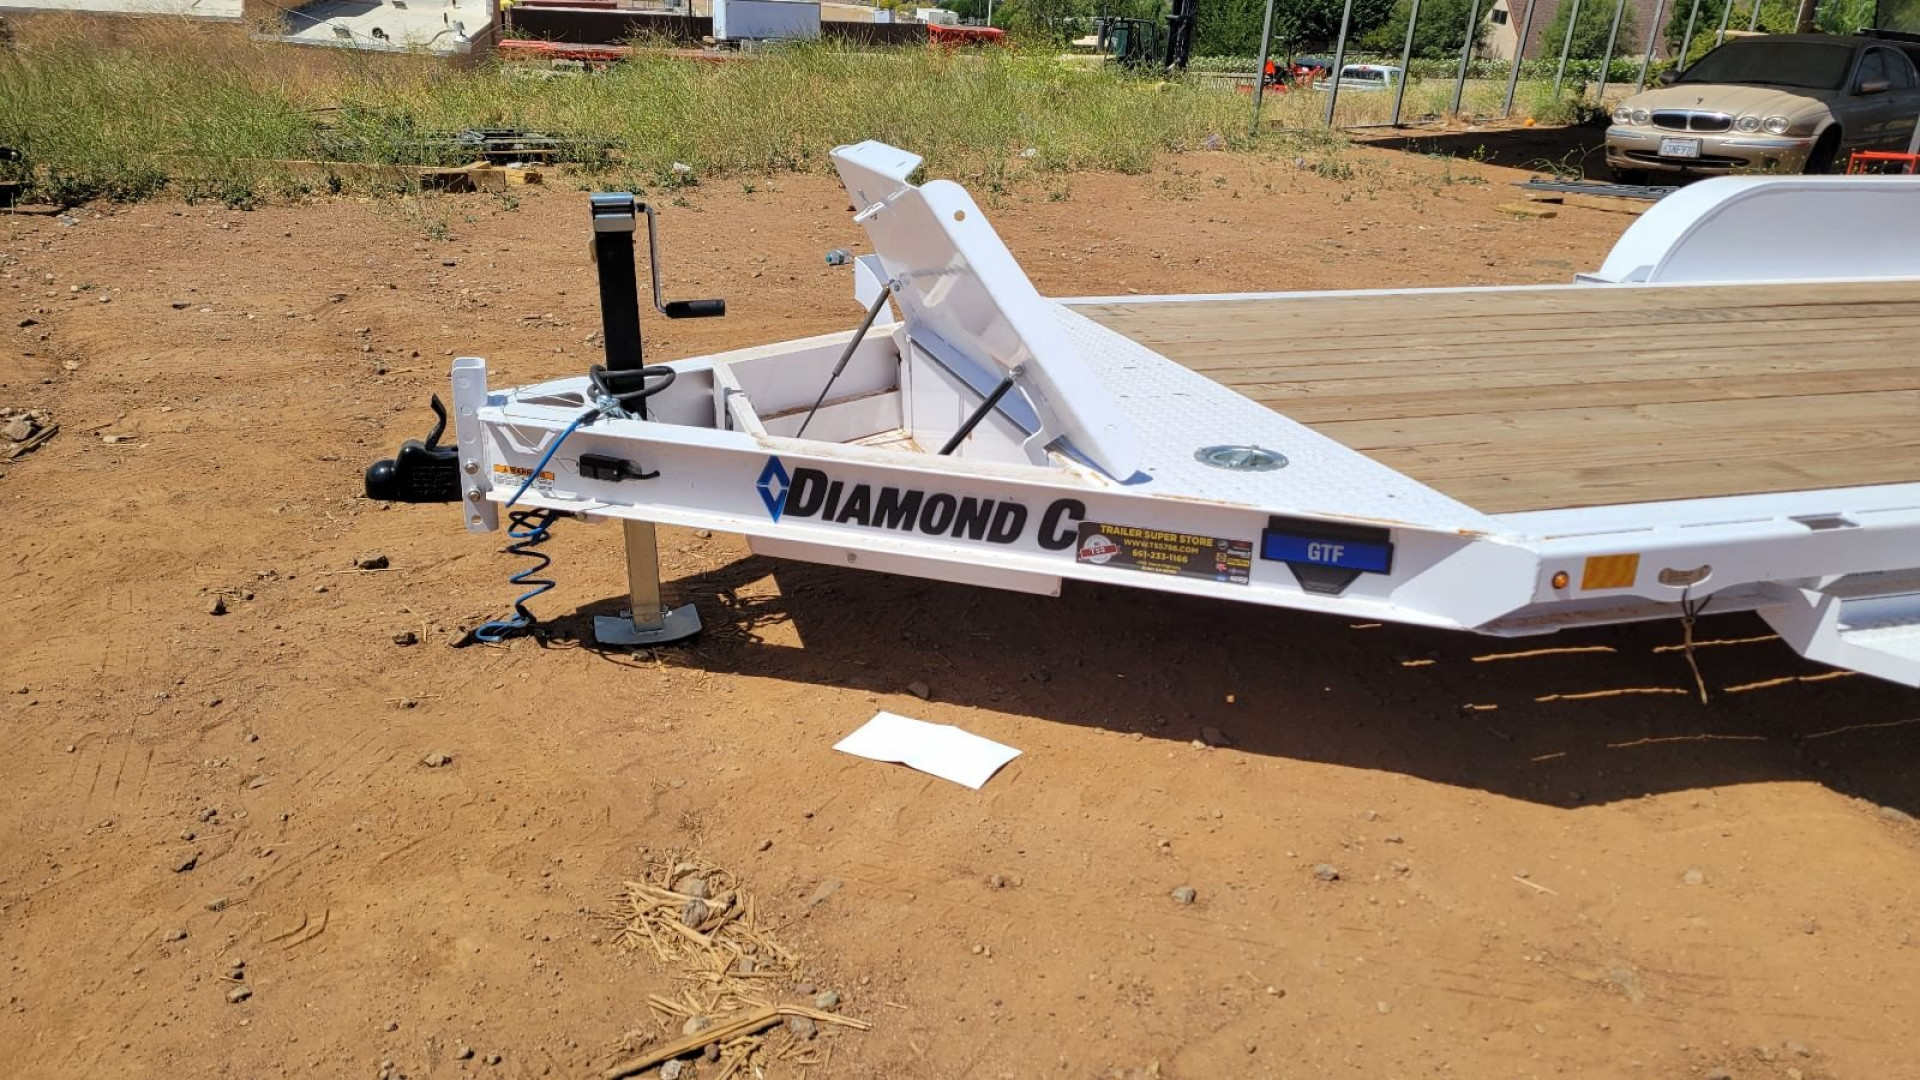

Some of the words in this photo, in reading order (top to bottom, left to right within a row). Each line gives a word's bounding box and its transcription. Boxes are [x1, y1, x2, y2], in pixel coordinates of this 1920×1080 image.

[509, 466, 546, 478] WARNG
[1037, 498, 1086, 551] C
[1100, 525, 1143, 538] TRAILER
[1144, 530, 1178, 542] SUPER
[1179, 535, 1214, 547] STORE
[1307, 542, 1345, 563] GTF
